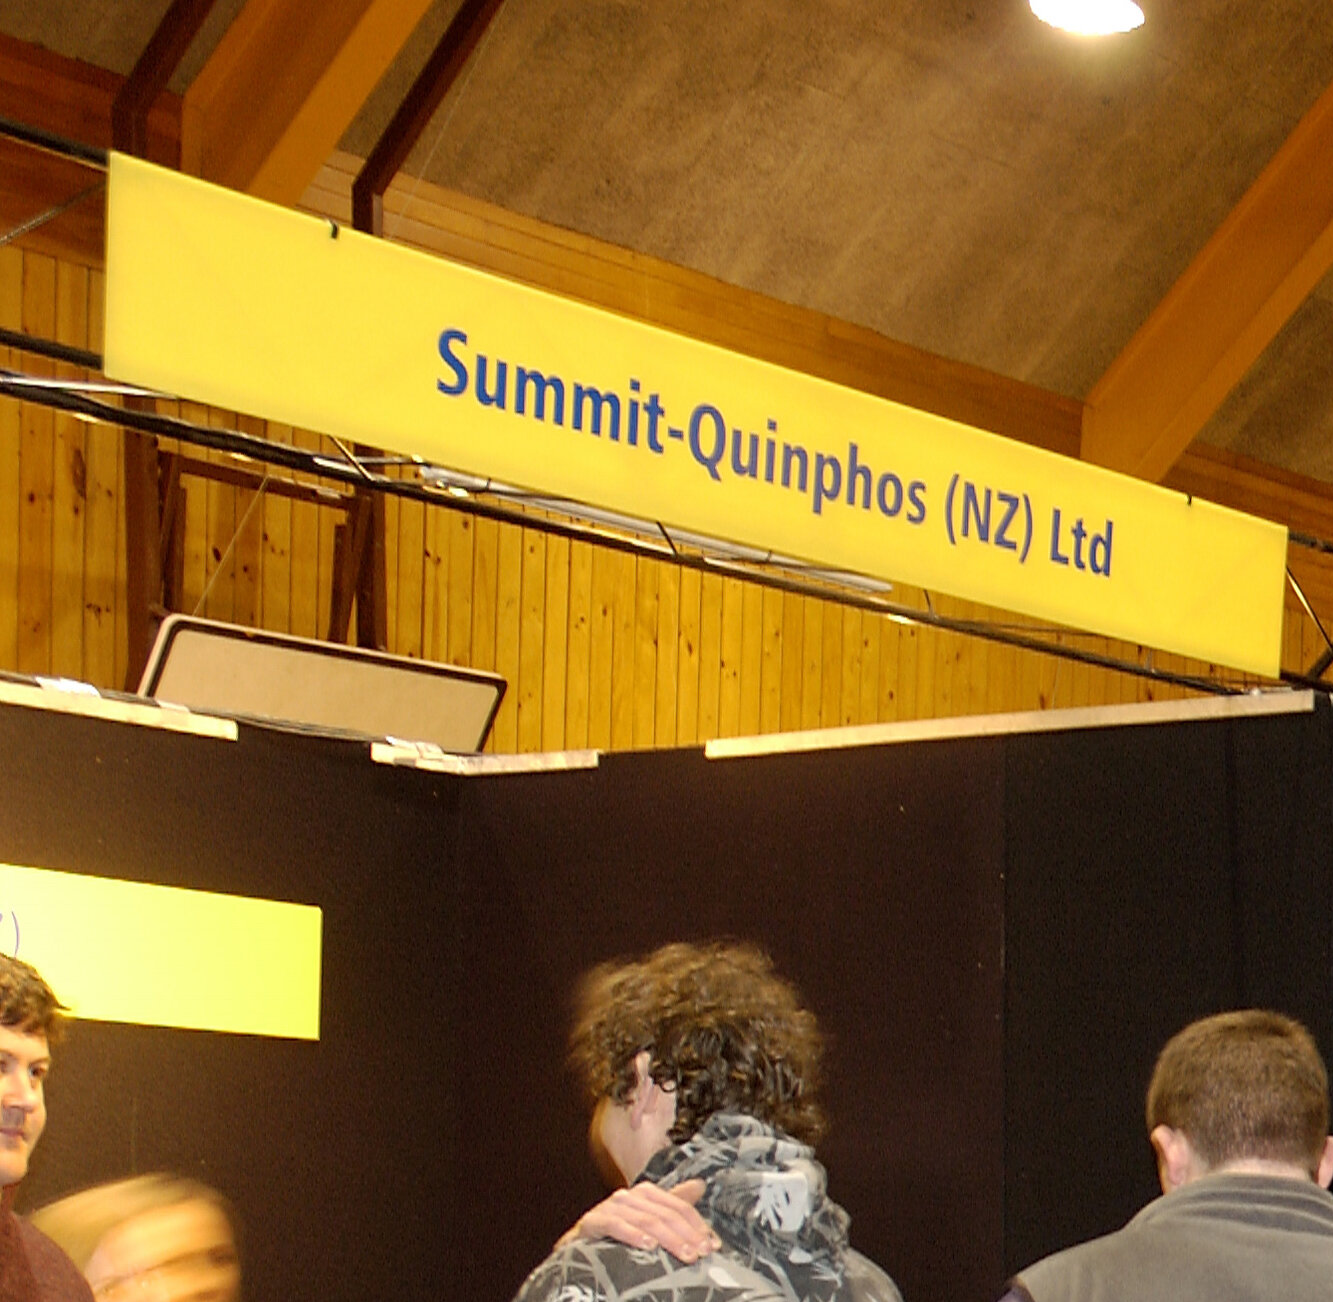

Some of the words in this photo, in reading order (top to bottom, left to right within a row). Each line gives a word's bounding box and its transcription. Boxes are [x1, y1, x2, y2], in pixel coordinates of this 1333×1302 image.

[437, 328, 927, 525] Summit-Quinphos
[944, 473, 1033, 564] (NZ)
[1050, 507, 1114, 577] Ltd
